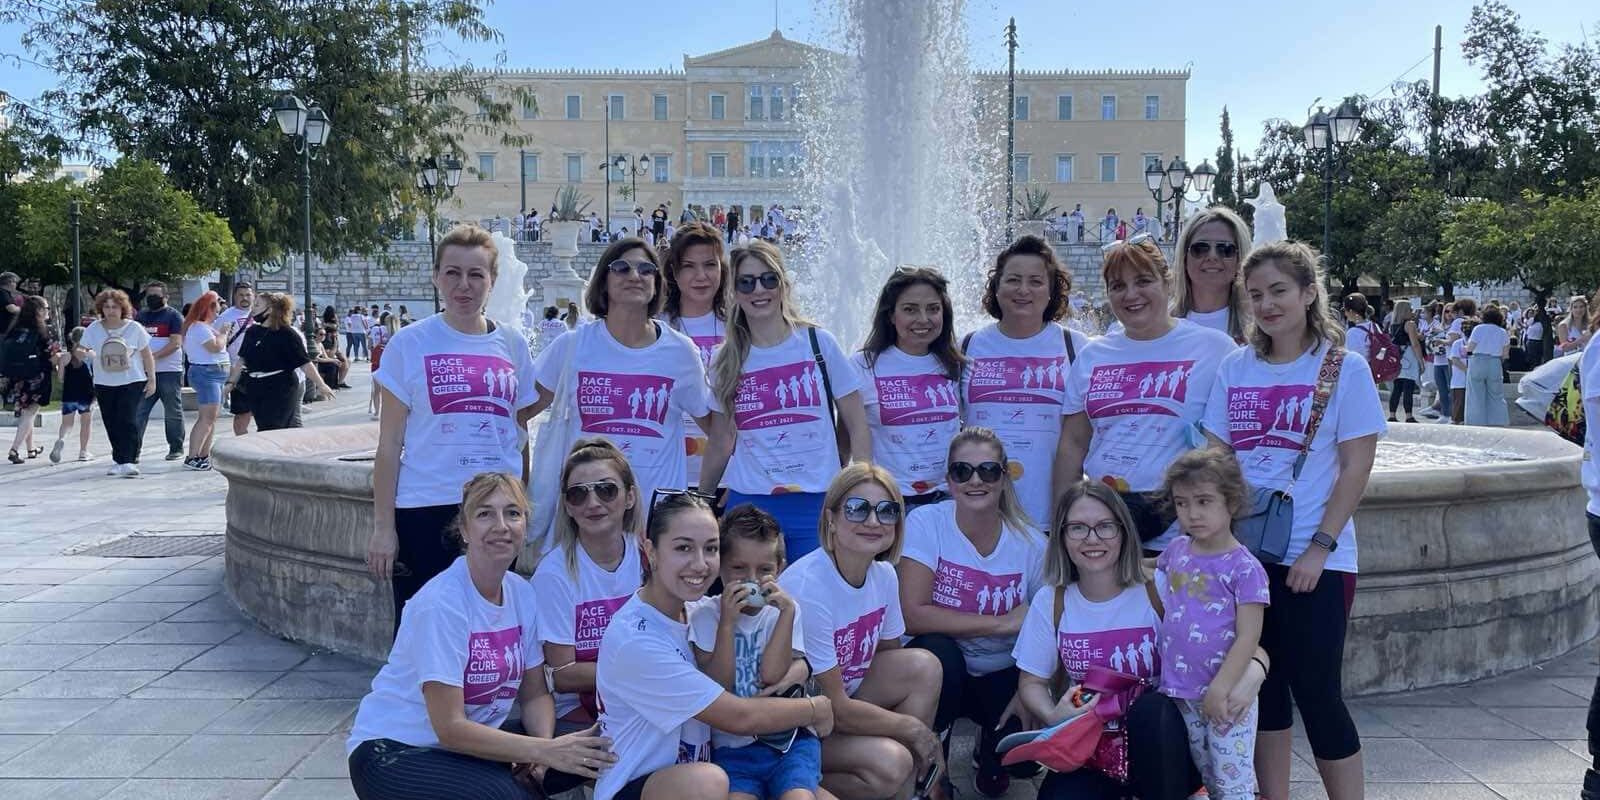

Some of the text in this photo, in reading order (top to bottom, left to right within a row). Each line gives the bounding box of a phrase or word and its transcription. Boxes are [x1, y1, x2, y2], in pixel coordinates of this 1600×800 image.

[430, 358, 463, 366] RACE
[431, 366, 476, 374] FOR THE
[1096, 368, 1126, 376] RACE
[582, 377, 612, 386] RACE
[1094, 374, 1136, 383] FOR THE
[434, 385, 468, 394] GREECE
[580, 386, 624, 396] FOR THE
[750, 384, 768, 392] THE
[902, 386, 918, 394] THE
[1232, 392, 1258, 401] RACE
[1229, 400, 1270, 410] FOR THE
[954, 578, 974, 591] THE
[1062, 648, 1104, 659] FOR THE
[470, 660, 496, 671] CURE
